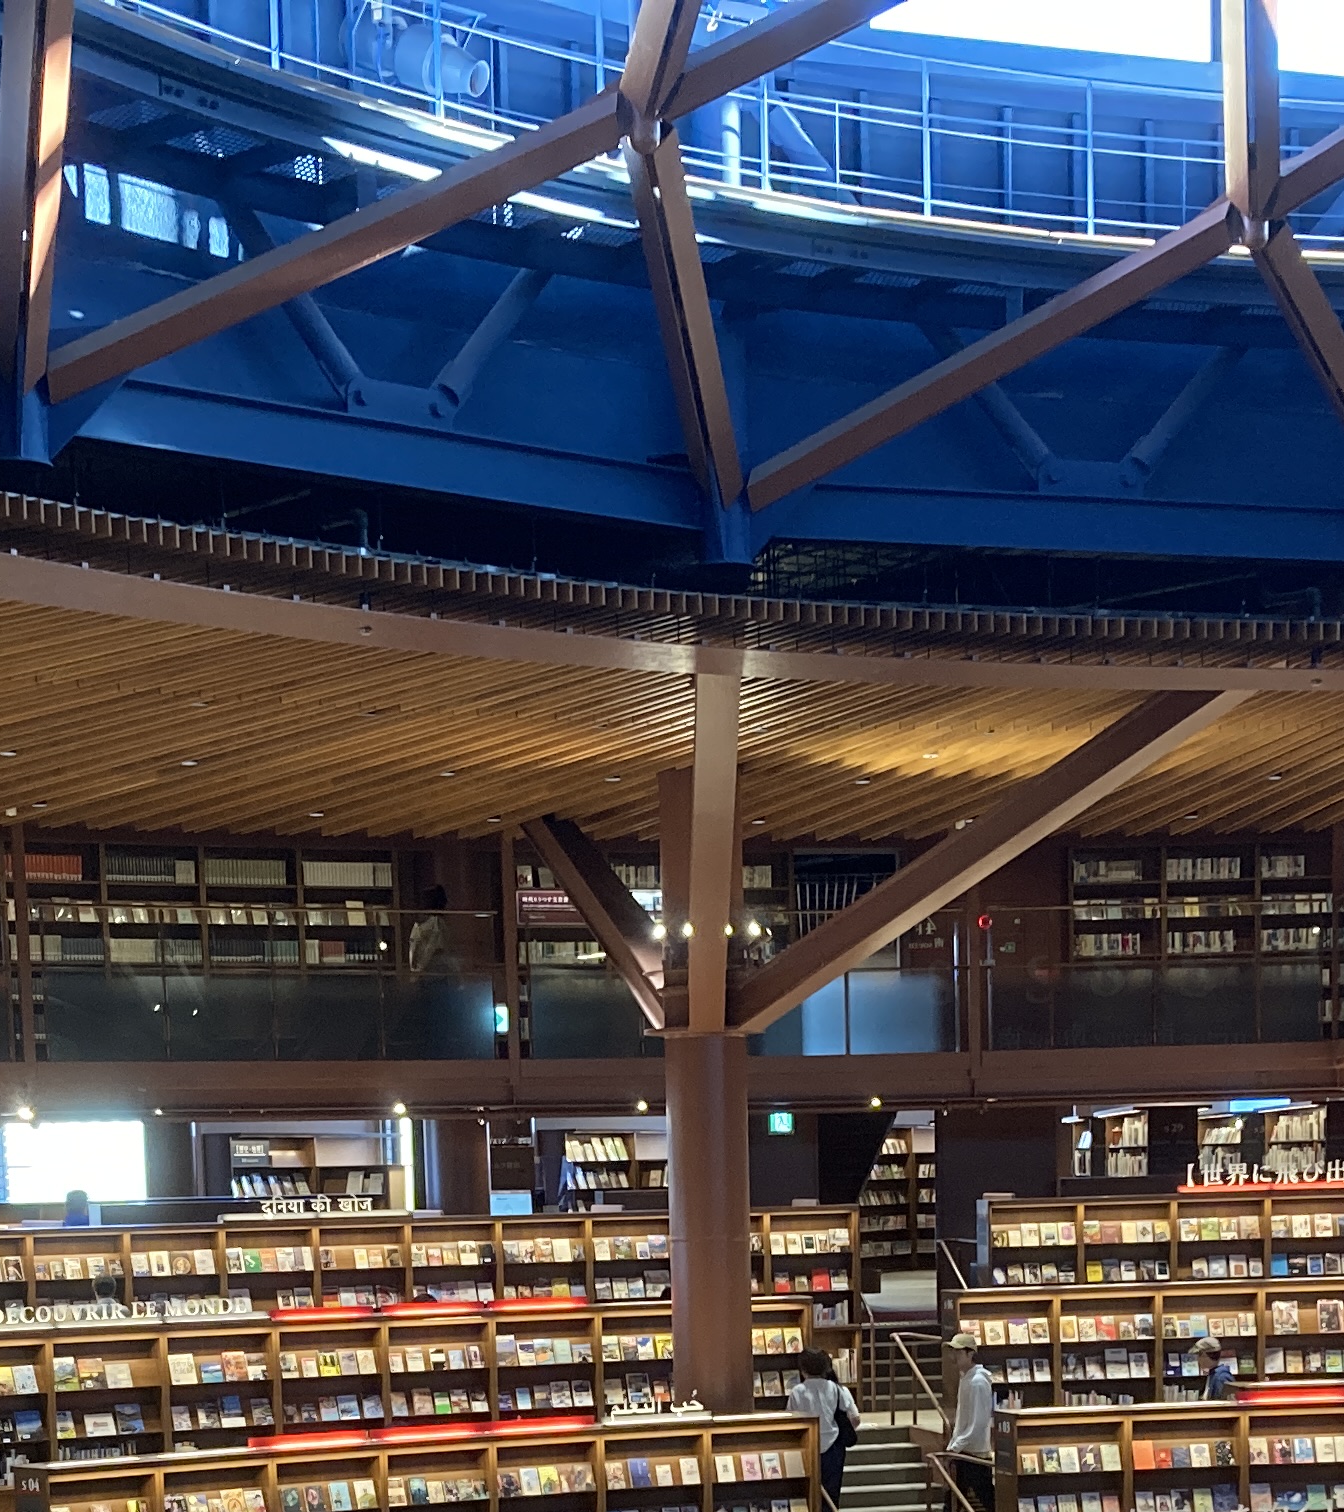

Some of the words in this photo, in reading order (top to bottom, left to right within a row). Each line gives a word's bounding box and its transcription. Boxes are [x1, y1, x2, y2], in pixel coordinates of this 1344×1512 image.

[260, 1196, 305, 1218] दुनिया
[311, 1194, 332, 1213] की
[337, 1194, 373, 1212] खोज
[131, 1301, 158, 1319] LE
[164, 1297, 248, 1317] MONDE
